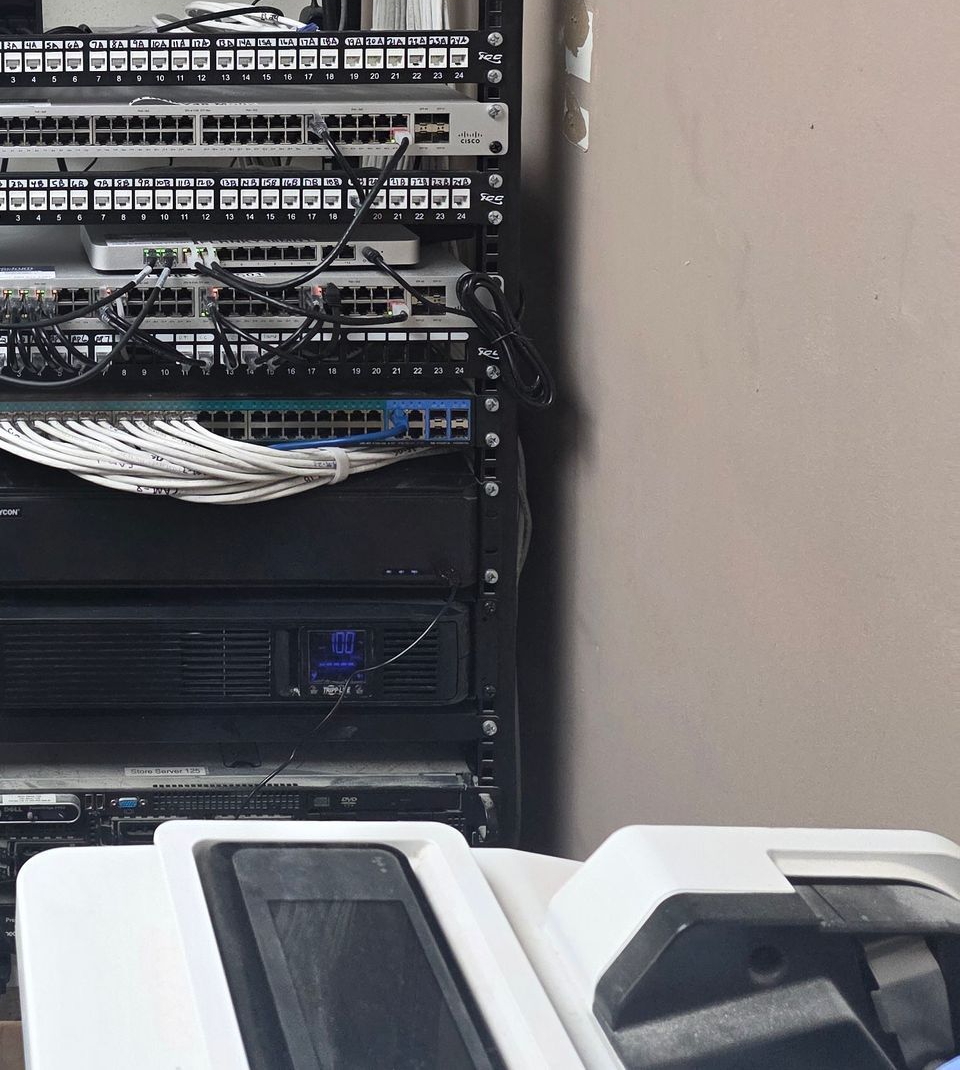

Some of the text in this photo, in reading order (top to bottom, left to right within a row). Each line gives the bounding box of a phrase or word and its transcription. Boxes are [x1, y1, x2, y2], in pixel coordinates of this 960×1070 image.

[325, 73, 335, 81] 18
[433, 72, 443, 80] 23
[372, 213, 383, 221] 20
[433, 367, 444, 375] 23
[454, 367, 465, 375] 24
[332, 631, 355, 654] 100
